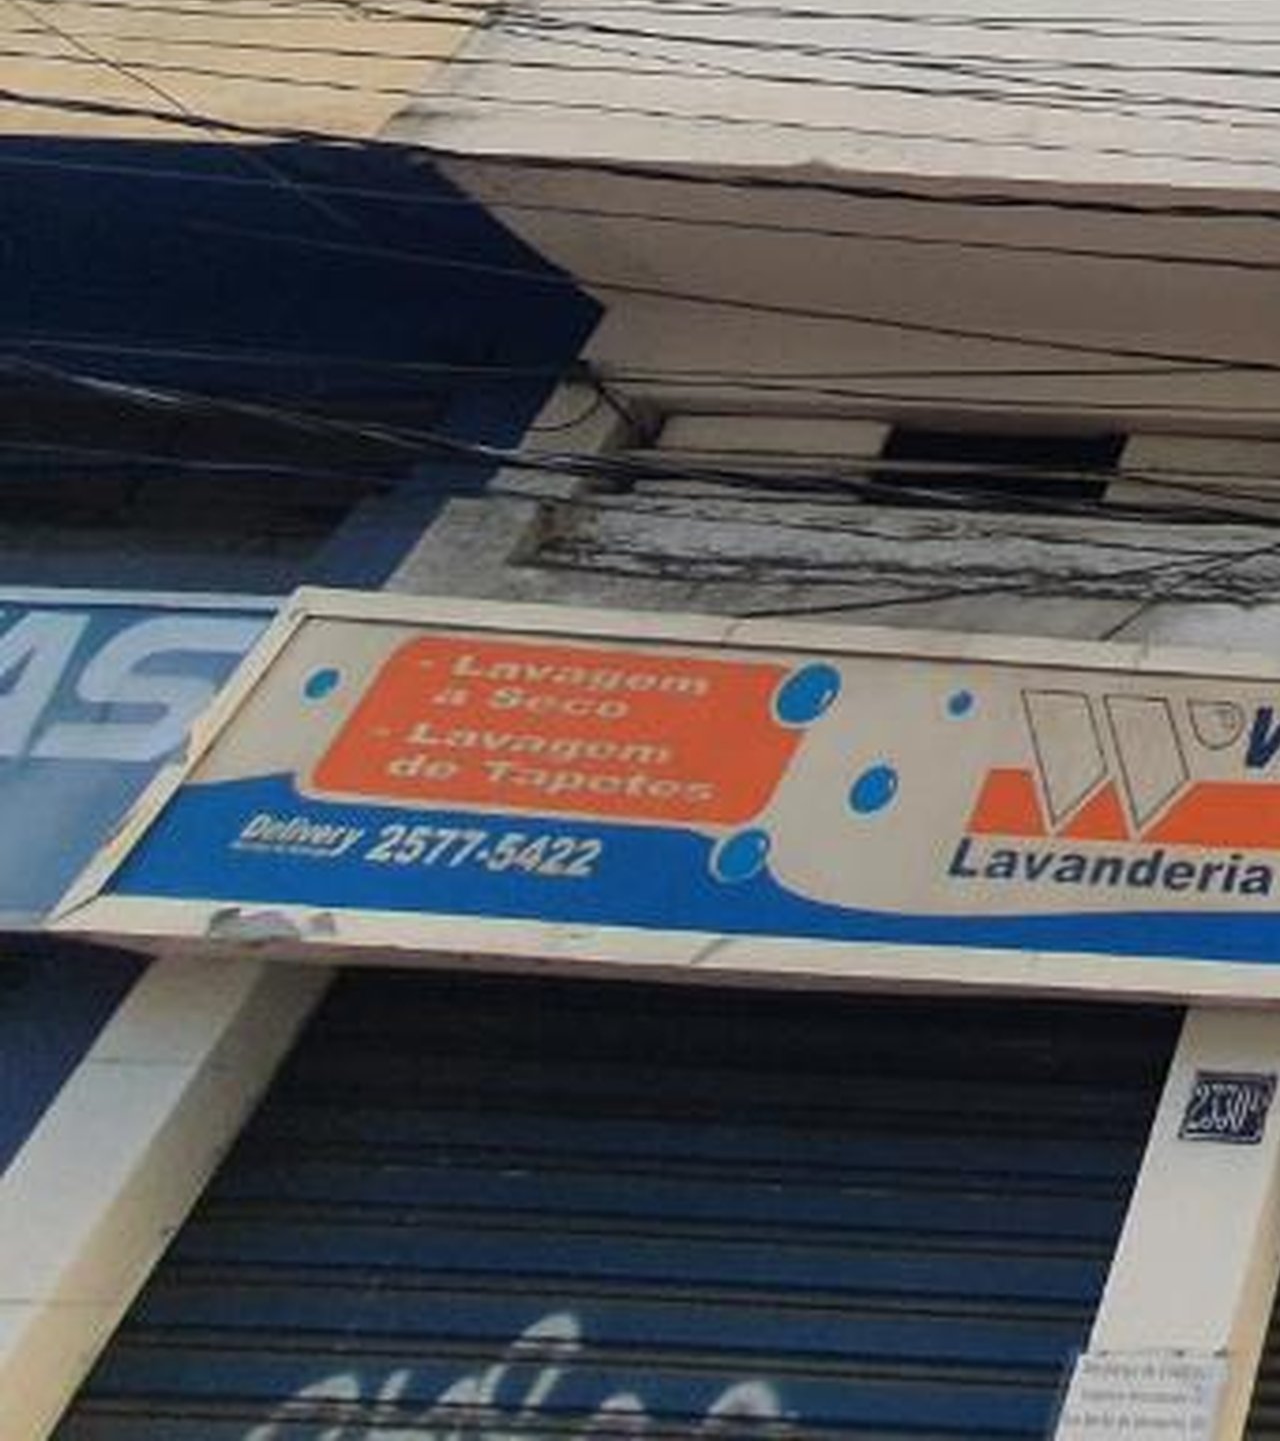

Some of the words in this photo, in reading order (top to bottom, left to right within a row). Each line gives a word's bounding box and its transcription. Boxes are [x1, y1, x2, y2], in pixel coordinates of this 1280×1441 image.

[452, 654, 711, 697] Lavagem
[488, 686, 629, 719] Seco
[406, 722, 672, 766] Lavagem
[387, 755, 460, 781] de
[482, 760, 716, 803] Tapetes
[238, 812, 364, 857] Delivery
[364, 824, 602, 877] 2577-5422
[947, 837, 1274, 896] Lavanderia
